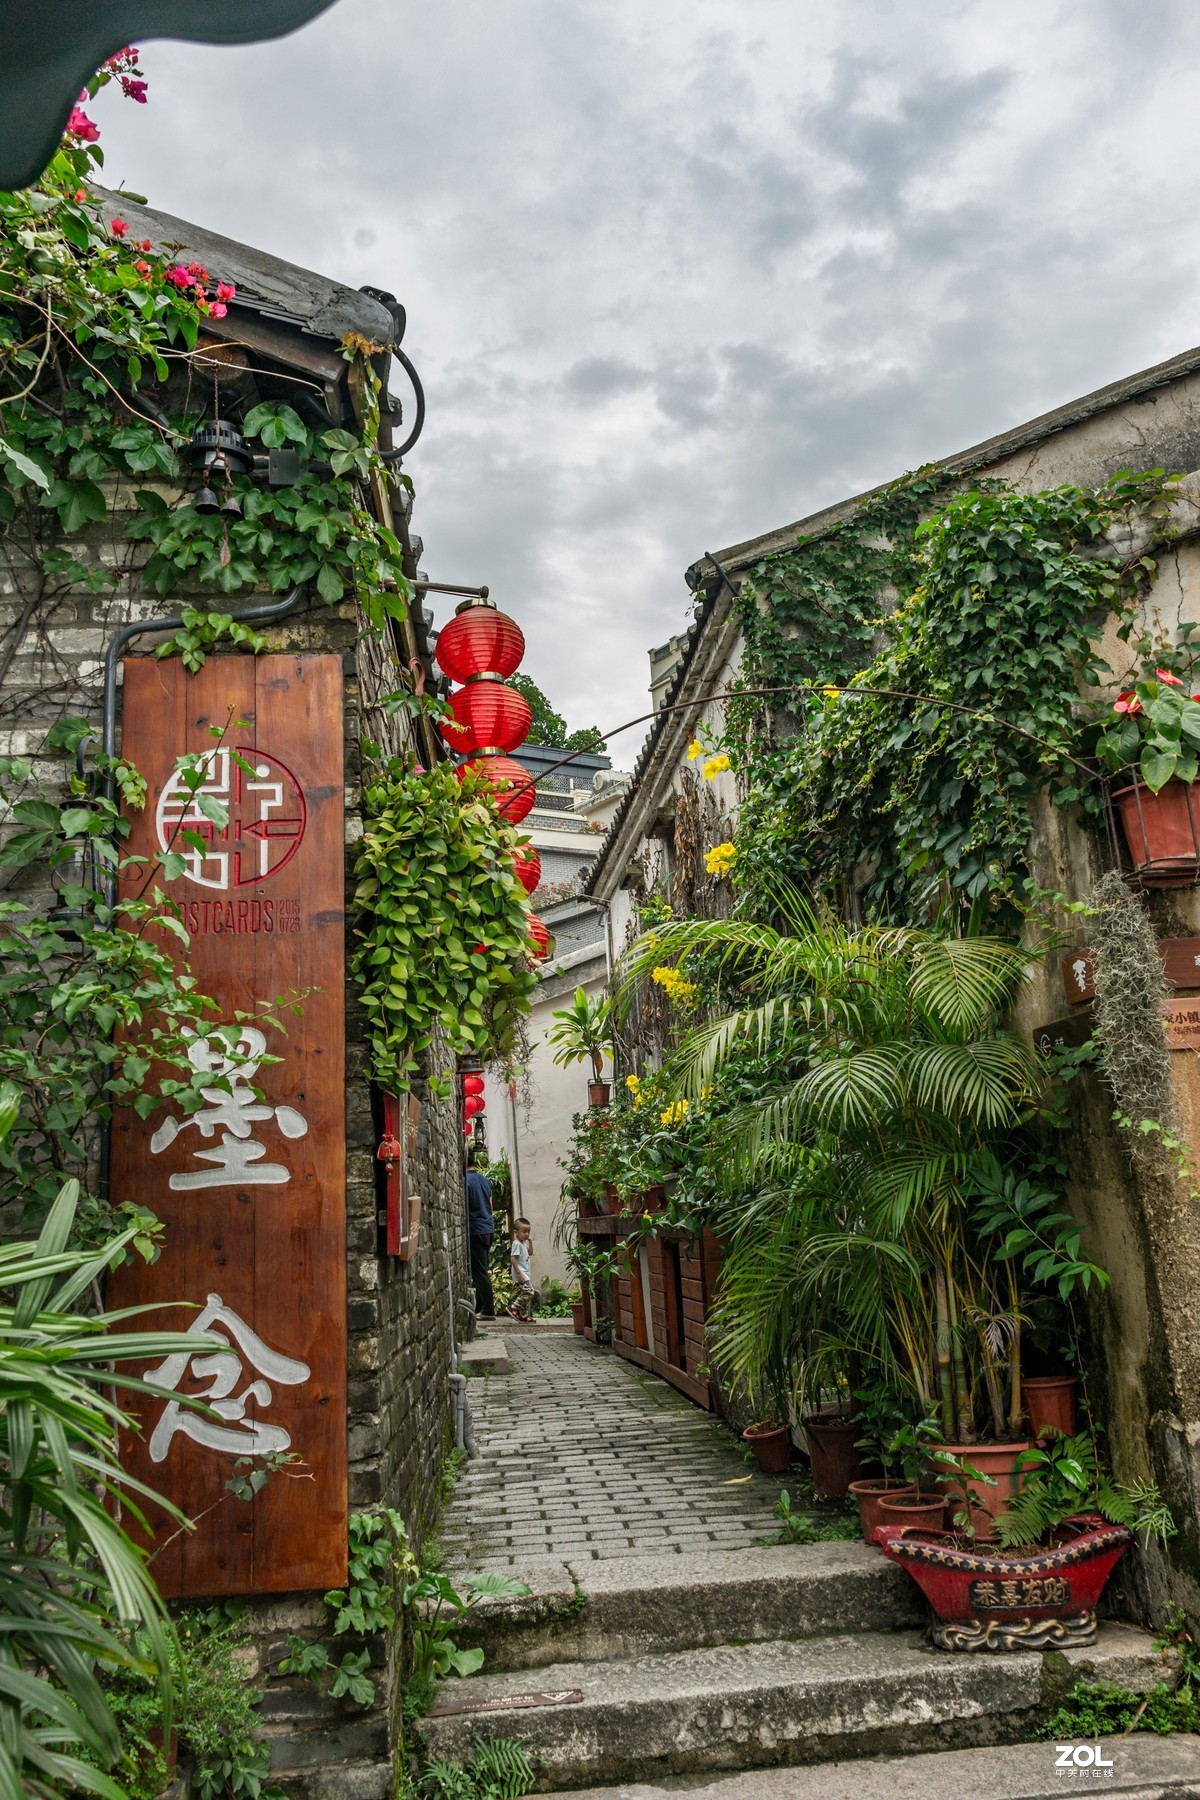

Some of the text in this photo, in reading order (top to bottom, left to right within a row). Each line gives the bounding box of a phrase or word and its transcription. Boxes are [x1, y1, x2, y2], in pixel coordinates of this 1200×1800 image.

[280, 900, 300, 915] 2015
[974, 1577, 1068, 1607] 恭喜发财
